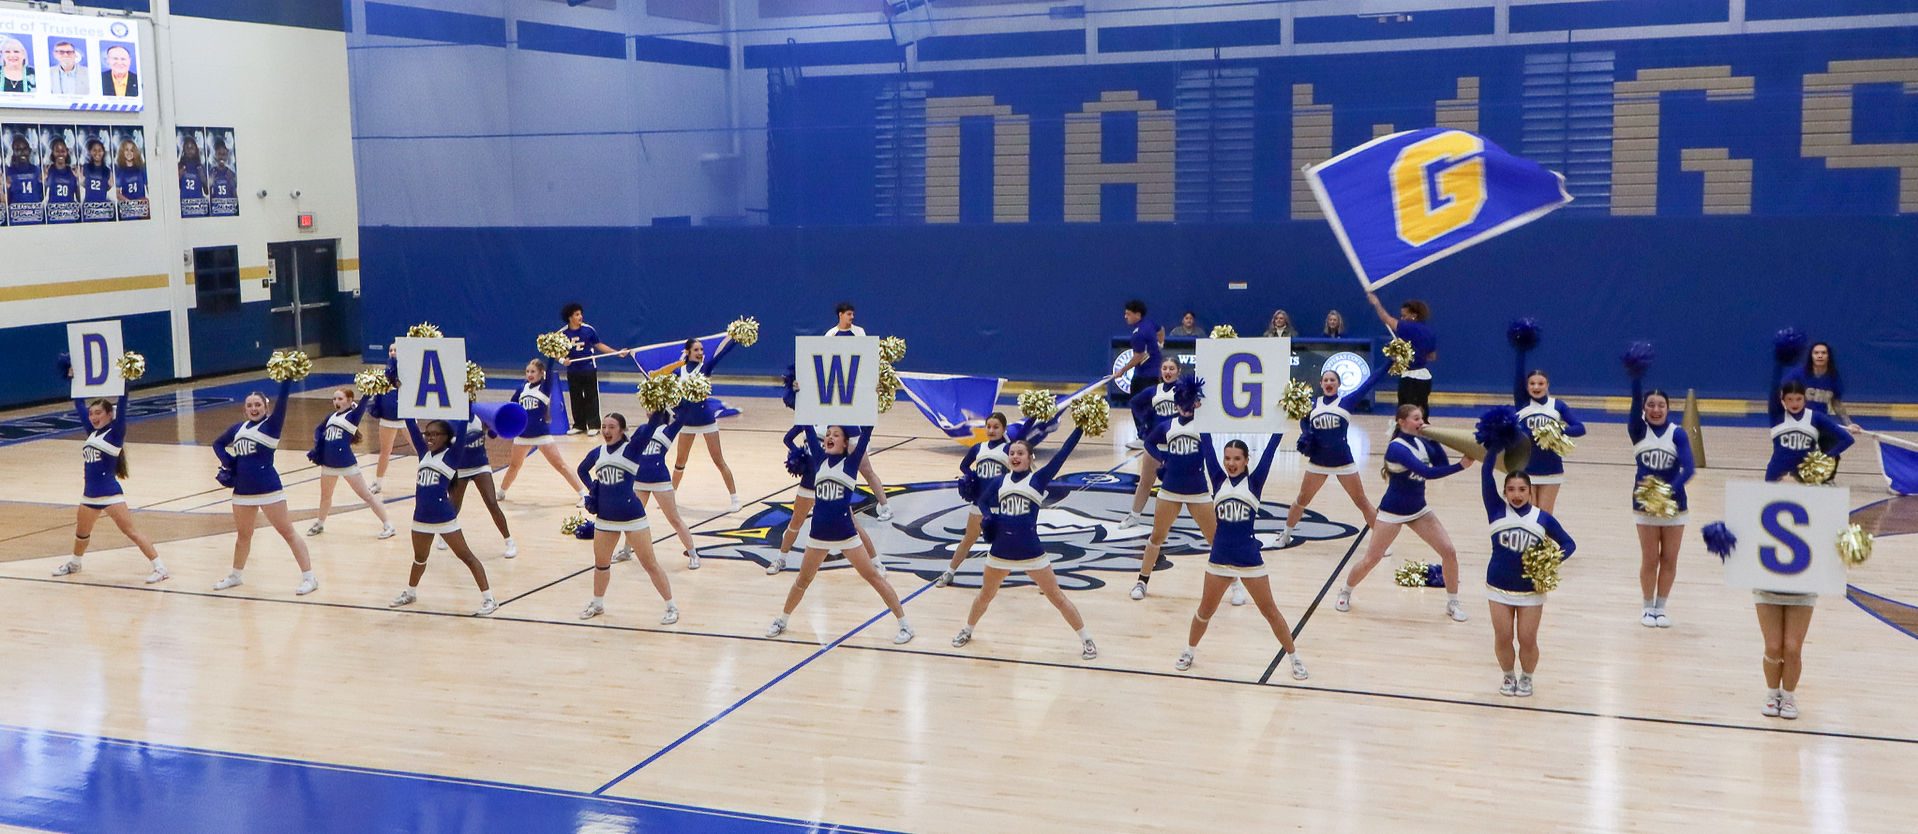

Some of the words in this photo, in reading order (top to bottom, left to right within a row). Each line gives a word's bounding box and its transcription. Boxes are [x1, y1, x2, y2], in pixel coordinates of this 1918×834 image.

[20, 21, 35, 32] of
[40, 22, 105, 37] Trustees
[22, 181, 33, 194] 14
[57, 184, 68, 197] 20
[90, 179, 101, 190] 22
[128, 182, 138, 193] 24
[185, 179, 195, 190] 32
[217, 185, 227, 195] 35
[1388, 129, 1488, 248] G
[82, 333, 109, 387] D
[413, 349, 452, 409] A
[811, 353, 862, 407] W
[1220, 351, 1264, 421] G
[1312, 414, 1341, 429] COVE
[1169, 437, 1199, 455] COVE
[1780, 433, 1812, 450] COVE
[1641, 450, 1676, 469] COVE
[976, 460, 1002, 479] COVE
[816, 482, 845, 501] COVE
[1000, 495, 1031, 516] COVE
[1217, 501, 1250, 522] COVE
[1757, 499, 1814, 576] S
